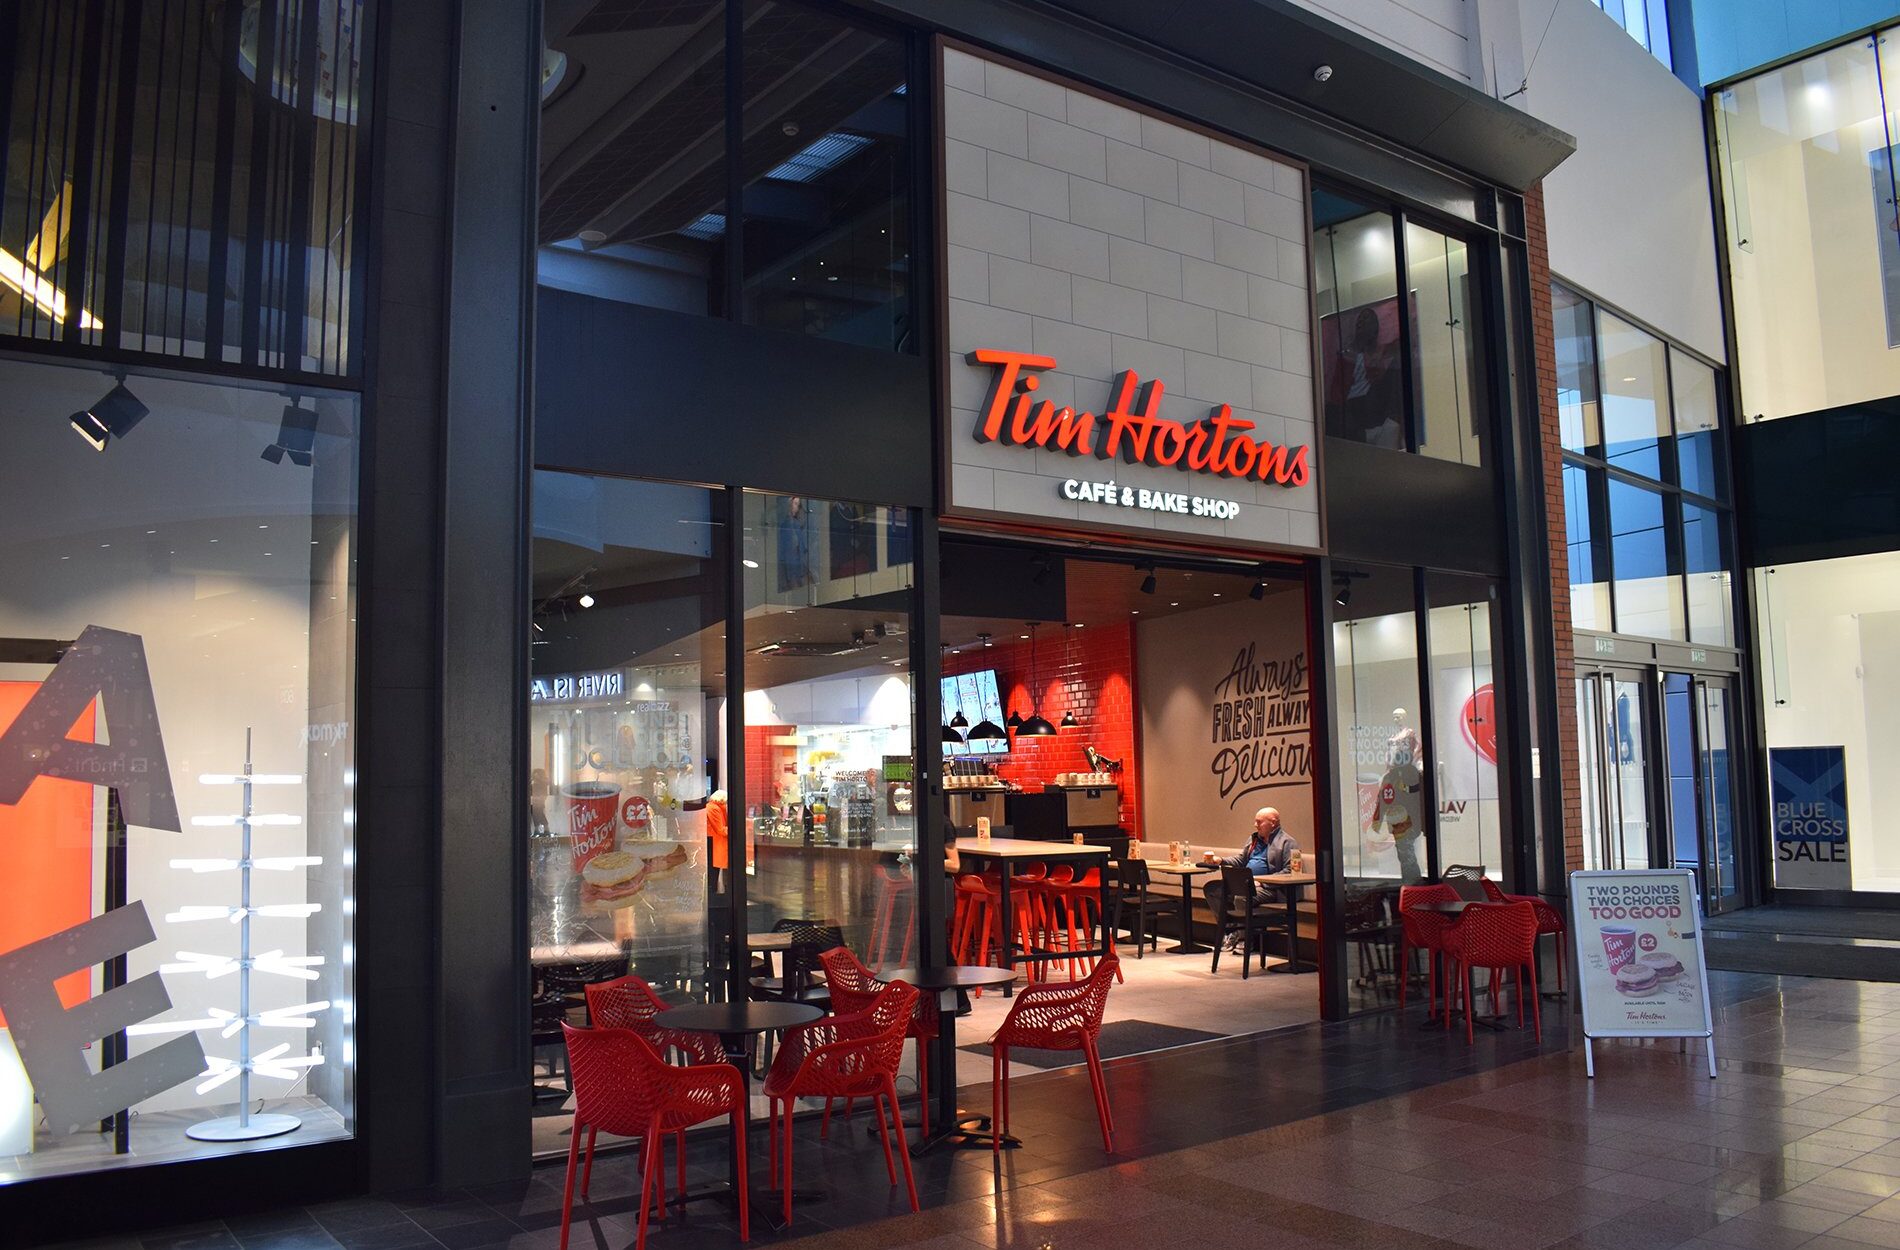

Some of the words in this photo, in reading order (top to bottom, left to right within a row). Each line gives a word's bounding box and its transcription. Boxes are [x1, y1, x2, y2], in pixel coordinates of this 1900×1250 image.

[968, 349, 1096, 456] Tim
[1098, 368, 1310, 488] Hortons
[1063, 479, 1117, 504] CAFÉ
[1120, 487, 1135, 508] &
[1138, 488, 1189, 514] BAKE
[1191, 496, 1241, 520] SHOP
[1214, 641, 1308, 701] Always
[1212, 696, 1266, 744] FRESH
[1383, 788, 1394, 799] £2
[567, 803, 599, 831] Tim
[626, 804, 648, 820] £2
[1776, 802, 1827, 818] BLUE
[1778, 819, 1844, 836] CROSS
[1778, 840, 1847, 862] SALE
[1586, 885, 1620, 896] TWO
[1622, 884, 1680, 895] POUNDS
[1587, 896, 1621, 906] TWO
[1623, 895, 1681, 906] CHOICES
[1588, 906, 1628, 920] TOO
[1628, 905, 1682, 919] GOOD
[1604, 937, 1624, 952] Tim
[1641, 937, 1655, 947] £2
[1626, 1011, 1639, 1020] Tim
